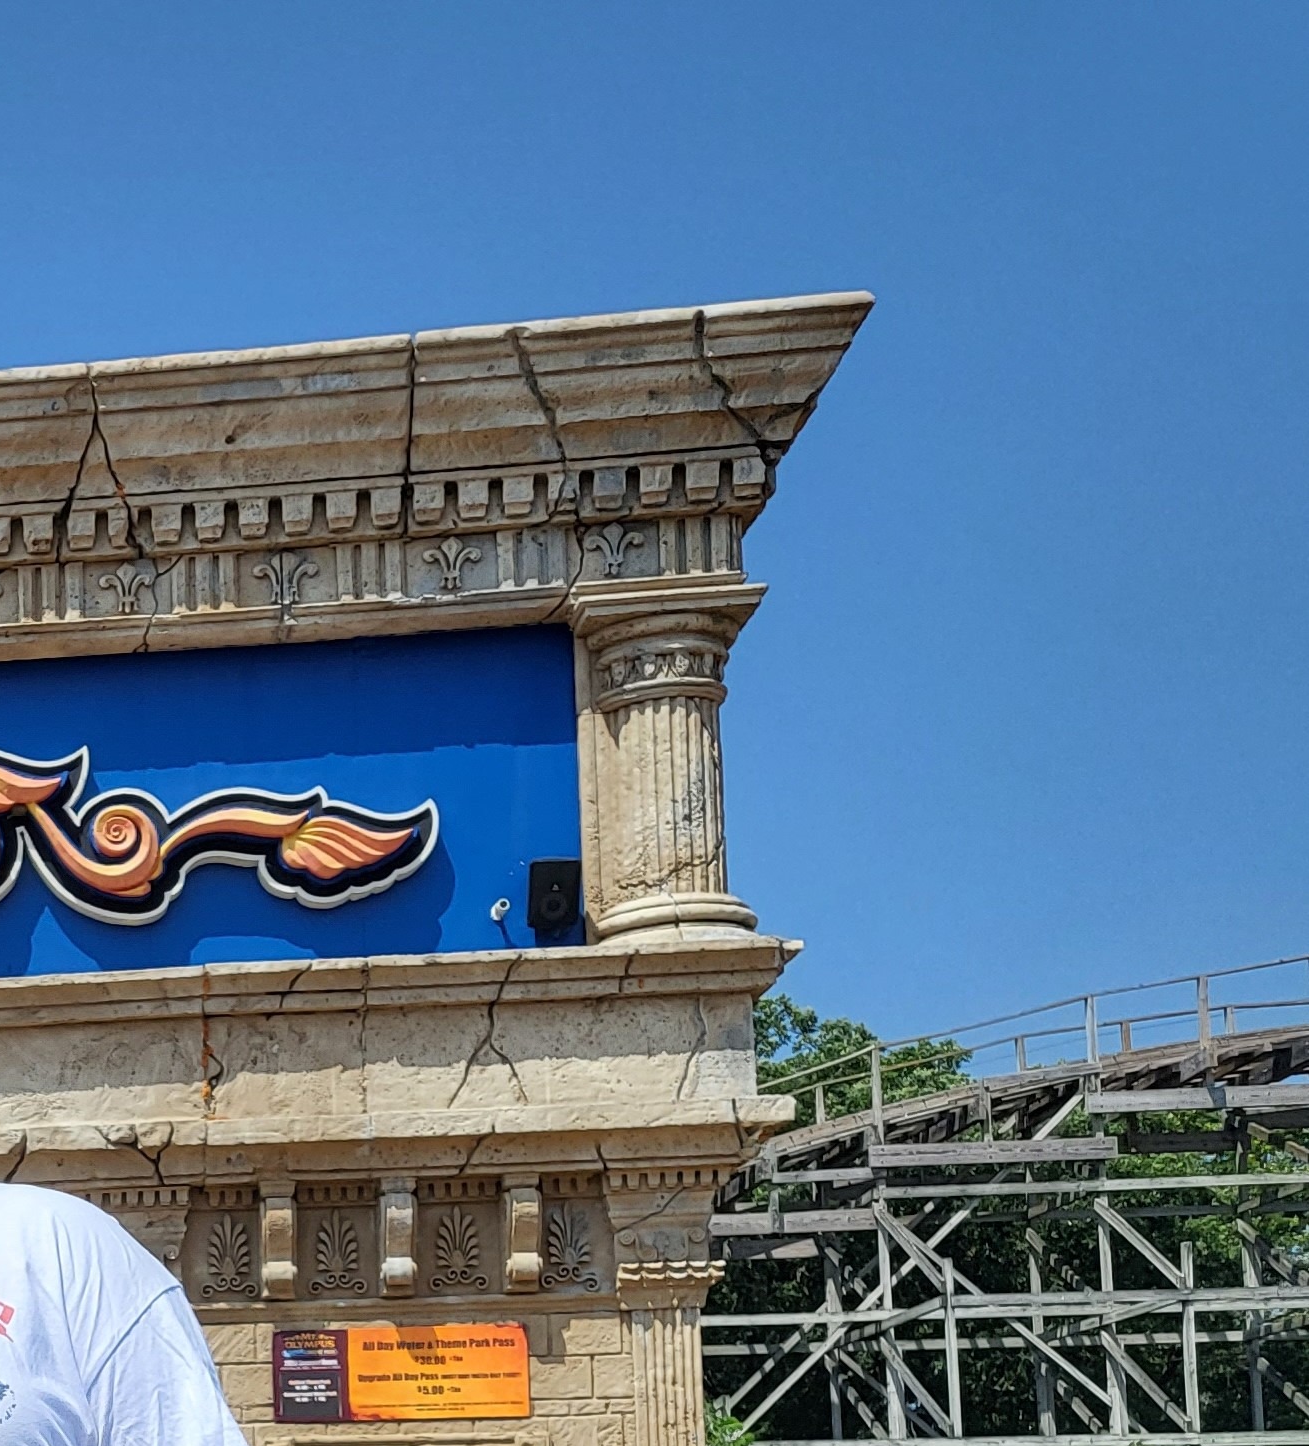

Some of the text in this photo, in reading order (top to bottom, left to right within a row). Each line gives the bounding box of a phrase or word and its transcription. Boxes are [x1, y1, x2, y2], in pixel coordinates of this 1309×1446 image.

[284, 1340, 336, 1349] OLYMPUS
[377, 1342, 394, 1351] Day
[396, 1341, 425, 1350] Water
[436, 1340, 467, 1348] Theme
[469, 1338, 490, 1347] Park
[492, 1338, 515, 1347] Pass
